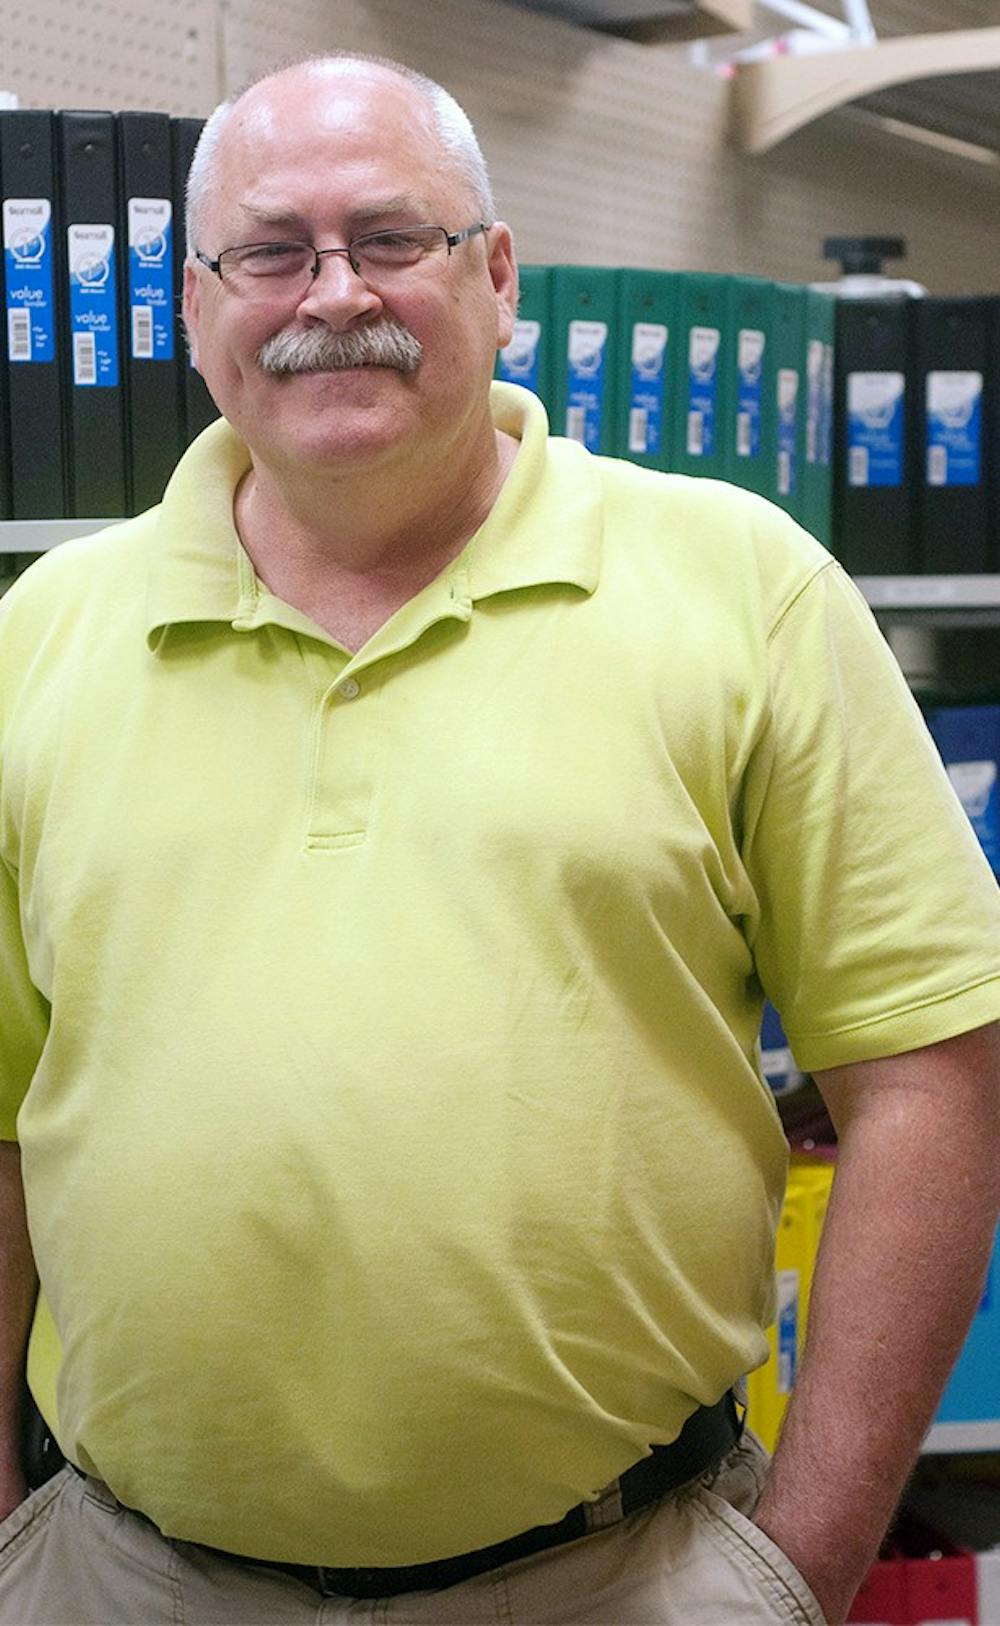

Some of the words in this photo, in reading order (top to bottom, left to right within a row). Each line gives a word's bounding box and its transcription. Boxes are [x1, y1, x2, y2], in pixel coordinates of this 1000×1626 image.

[9, 285, 43, 300] value
[134, 284, 165, 298] value
[74, 309, 108, 324] value
